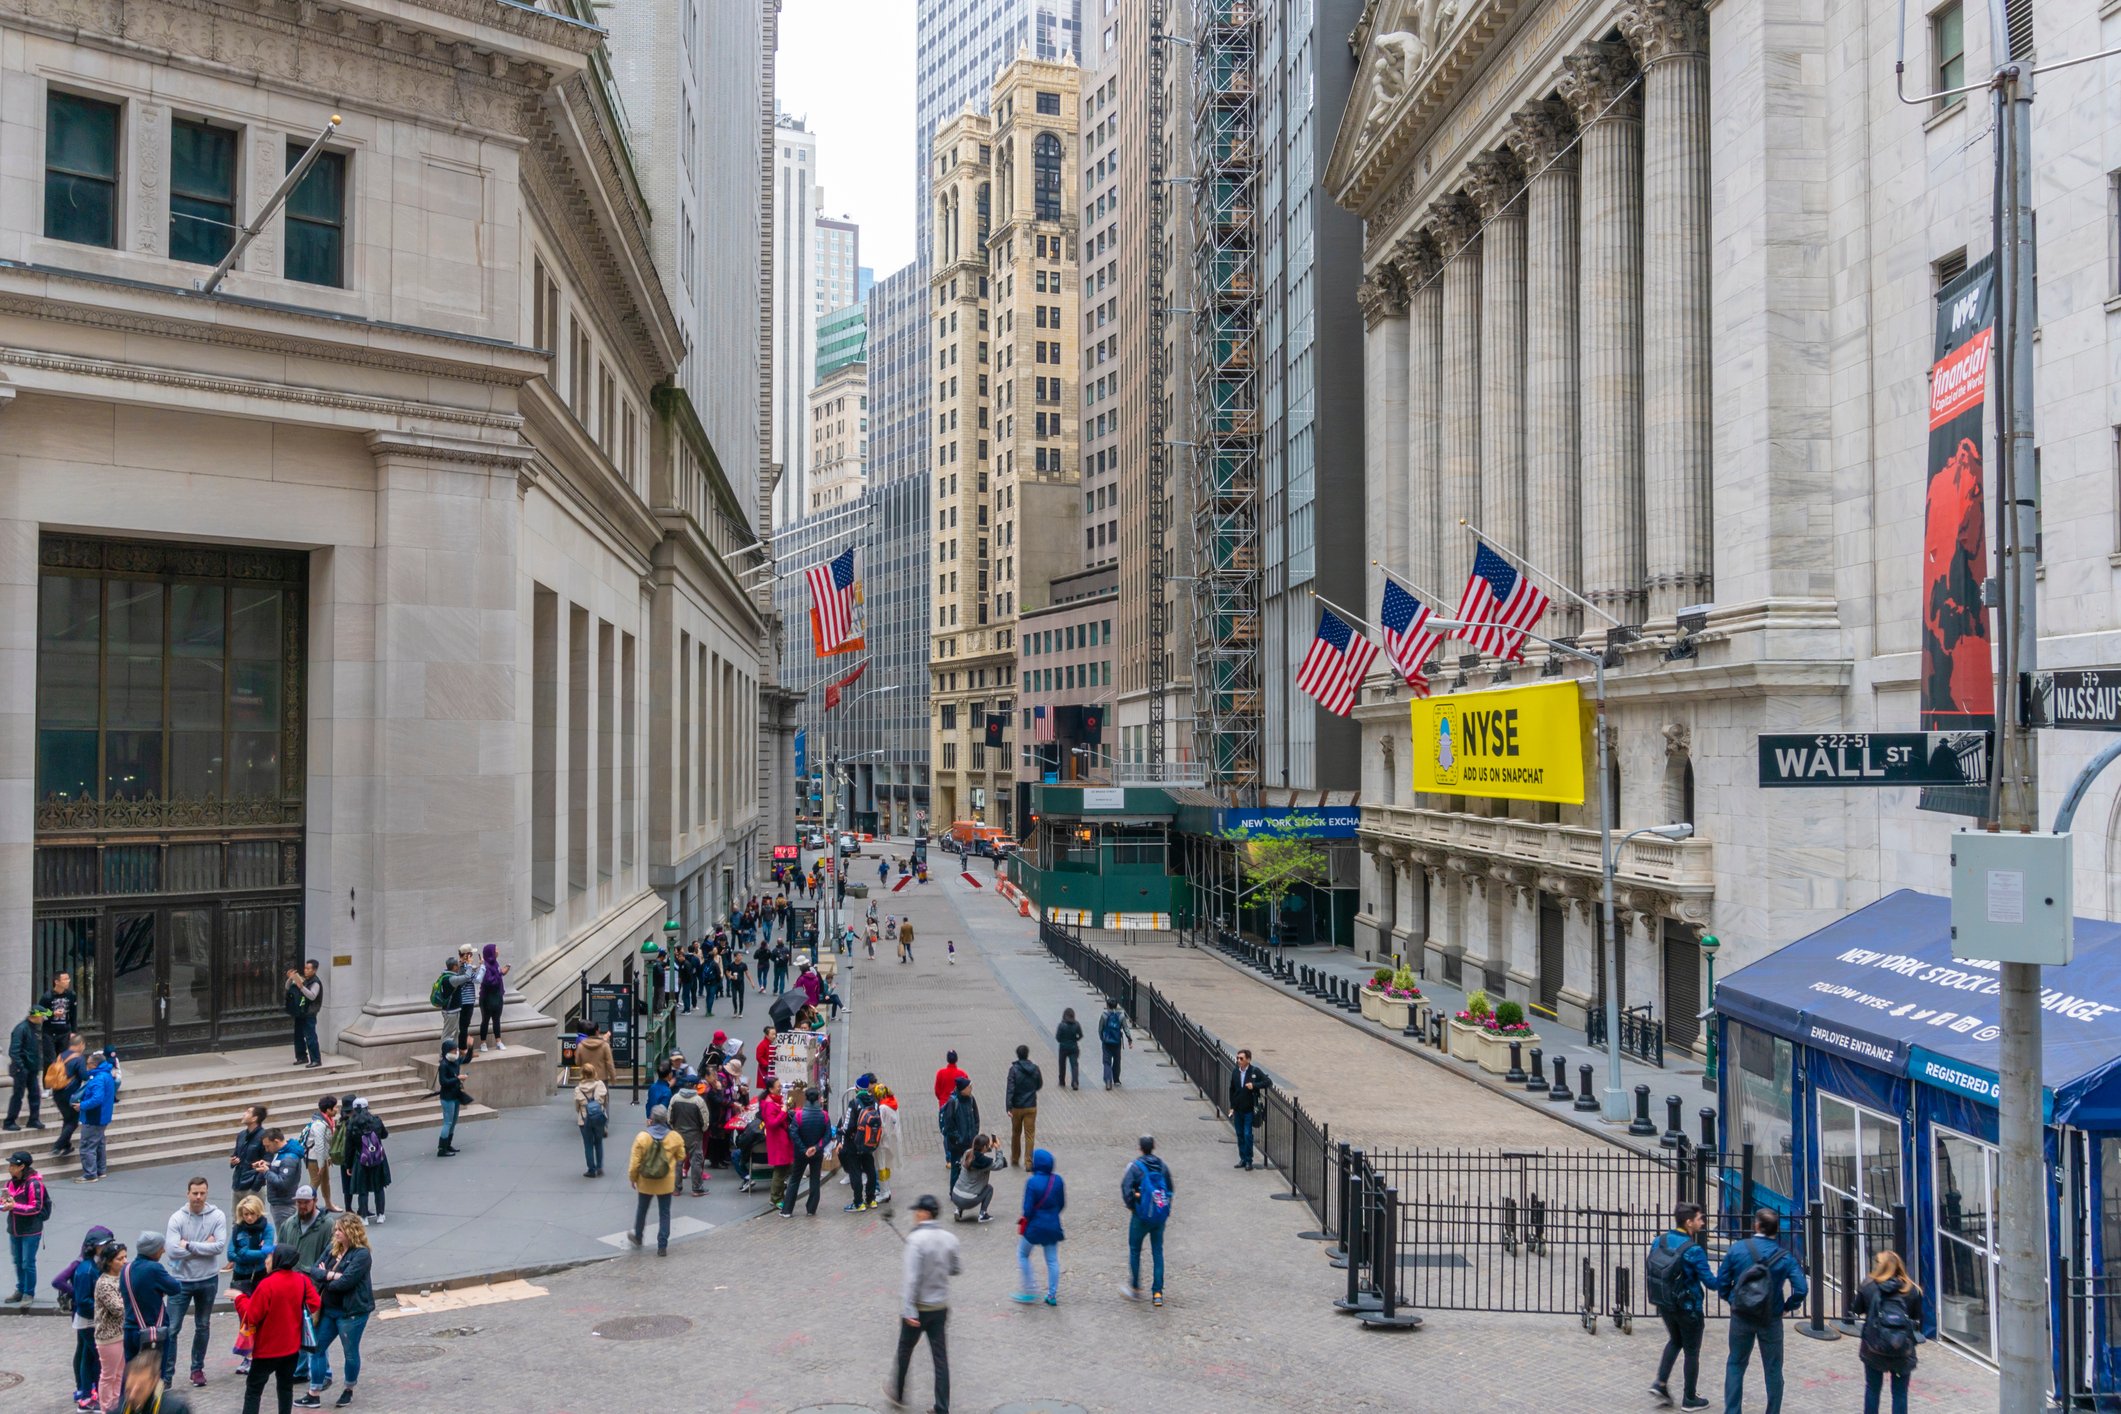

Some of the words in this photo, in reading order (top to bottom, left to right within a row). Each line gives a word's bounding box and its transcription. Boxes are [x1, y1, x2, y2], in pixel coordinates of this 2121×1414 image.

[1951, 287, 1980, 333] NYC
[1932, 335, 1989, 409] financial
[1966, 371, 1984, 392] World
[2057, 686, 2116, 720] NASSAU
[1462, 709, 1520, 757] NYSE
[1829, 734, 1870, 748] 22-51
[1463, 766, 1477, 781] ADD
[1478, 767, 1488, 781] US
[1489, 767, 1500, 782] ON
[1502, 767, 1544, 784] SNAPCHAT
[1775, 747, 1885, 778] WALL
[1886, 746, 1912, 763] ST
[1241, 819, 1264, 828] NEW
[1266, 818, 1292, 828] YORK
[1294, 817, 1326, 827] STOCK
[1836, 947, 1882, 966] NEW
[1875, 955, 1925, 977] YORK
[1918, 966, 1989, 993] STOCK
[1809, 981, 1859, 1000] FOLLOW
[1854, 993, 1895, 1011] NYSE
[1810, 1025, 1851, 1049] EMPLOYEE
[1850, 1038, 1894, 1063] ENTRANCE
[1925, 1061, 1989, 1094] REGISTERED
